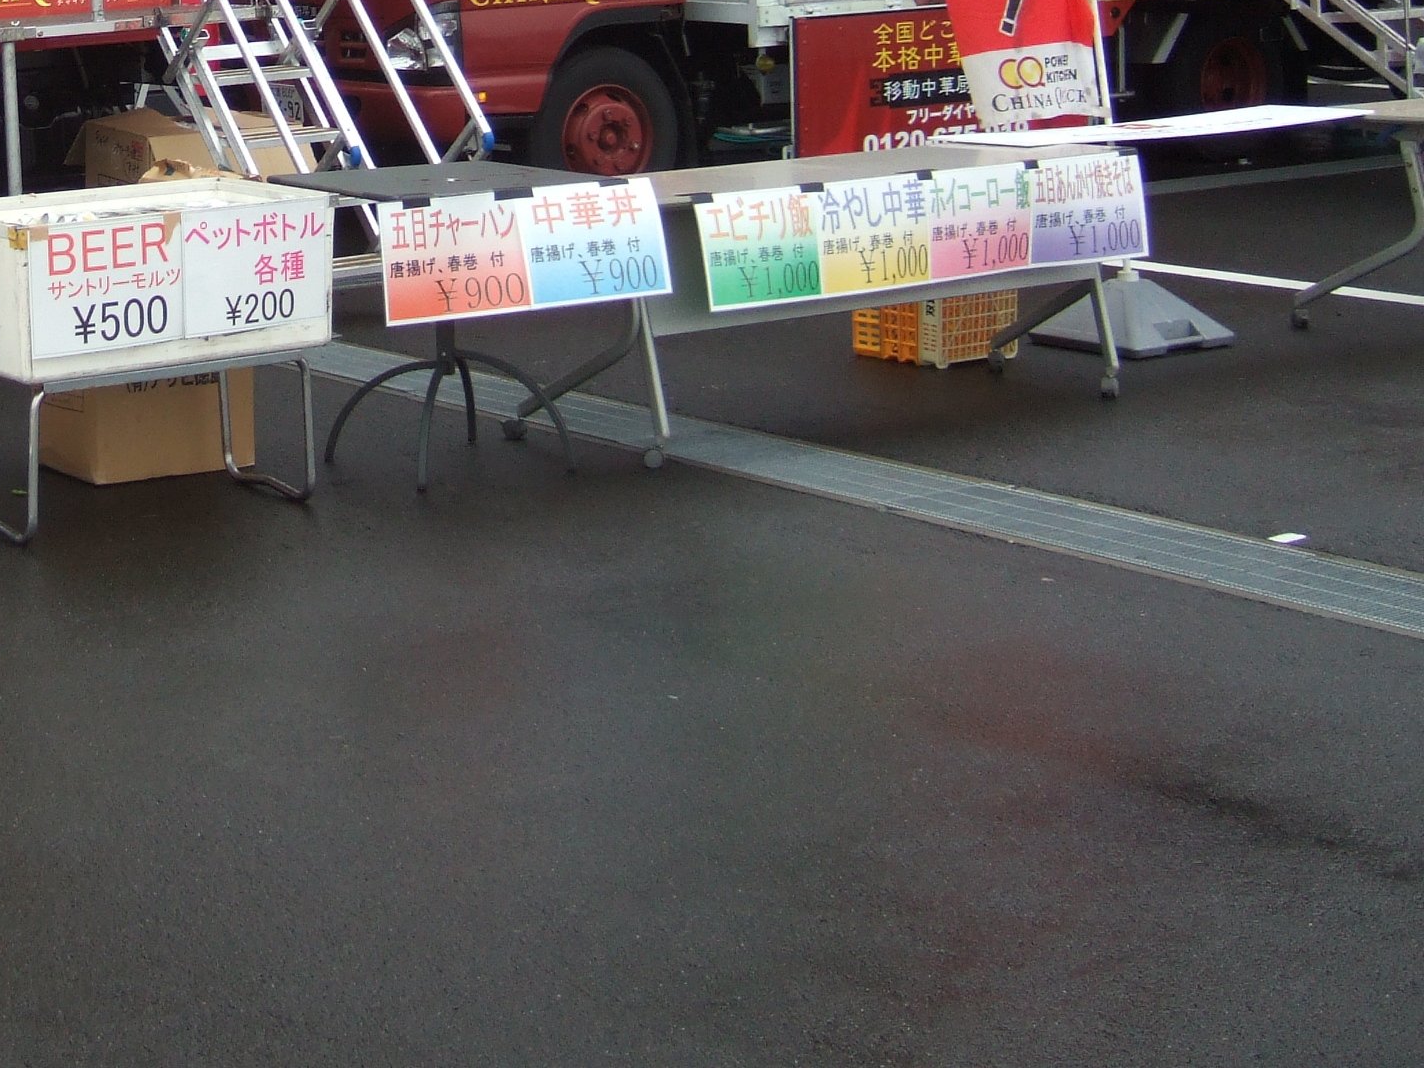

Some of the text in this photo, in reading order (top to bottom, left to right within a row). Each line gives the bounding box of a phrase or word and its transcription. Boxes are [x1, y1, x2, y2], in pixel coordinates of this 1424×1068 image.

[991, 92, 1054, 113] CHINA
[1034, 158, 1135, 204] 五目あんかけ焼きそば
[531, 188, 643, 233] 中華丼
[707, 193, 813, 241] エビチリ飯
[818, 179, 926, 234] 冷やし中華
[184, 212, 325, 251] ペットボトル
[389, 204, 516, 251] 五目チャーハン
[1069, 219, 1141, 256] ¥1,000
[47, 223, 170, 277] BEER
[254, 250, 307, 286] 各種
[860, 244, 928, 283] ¥1,000
[963, 232, 1029, 269] ¥1,000
[47, 269, 182, 301] サントリーモルツ
[436, 273, 526, 312] ¥900
[580, 254, 659, 294] ¥900
[738, 260, 820, 298] ¥1,000
[74, 295, 169, 344] ¥500
[225, 289, 295, 327] ¥200
